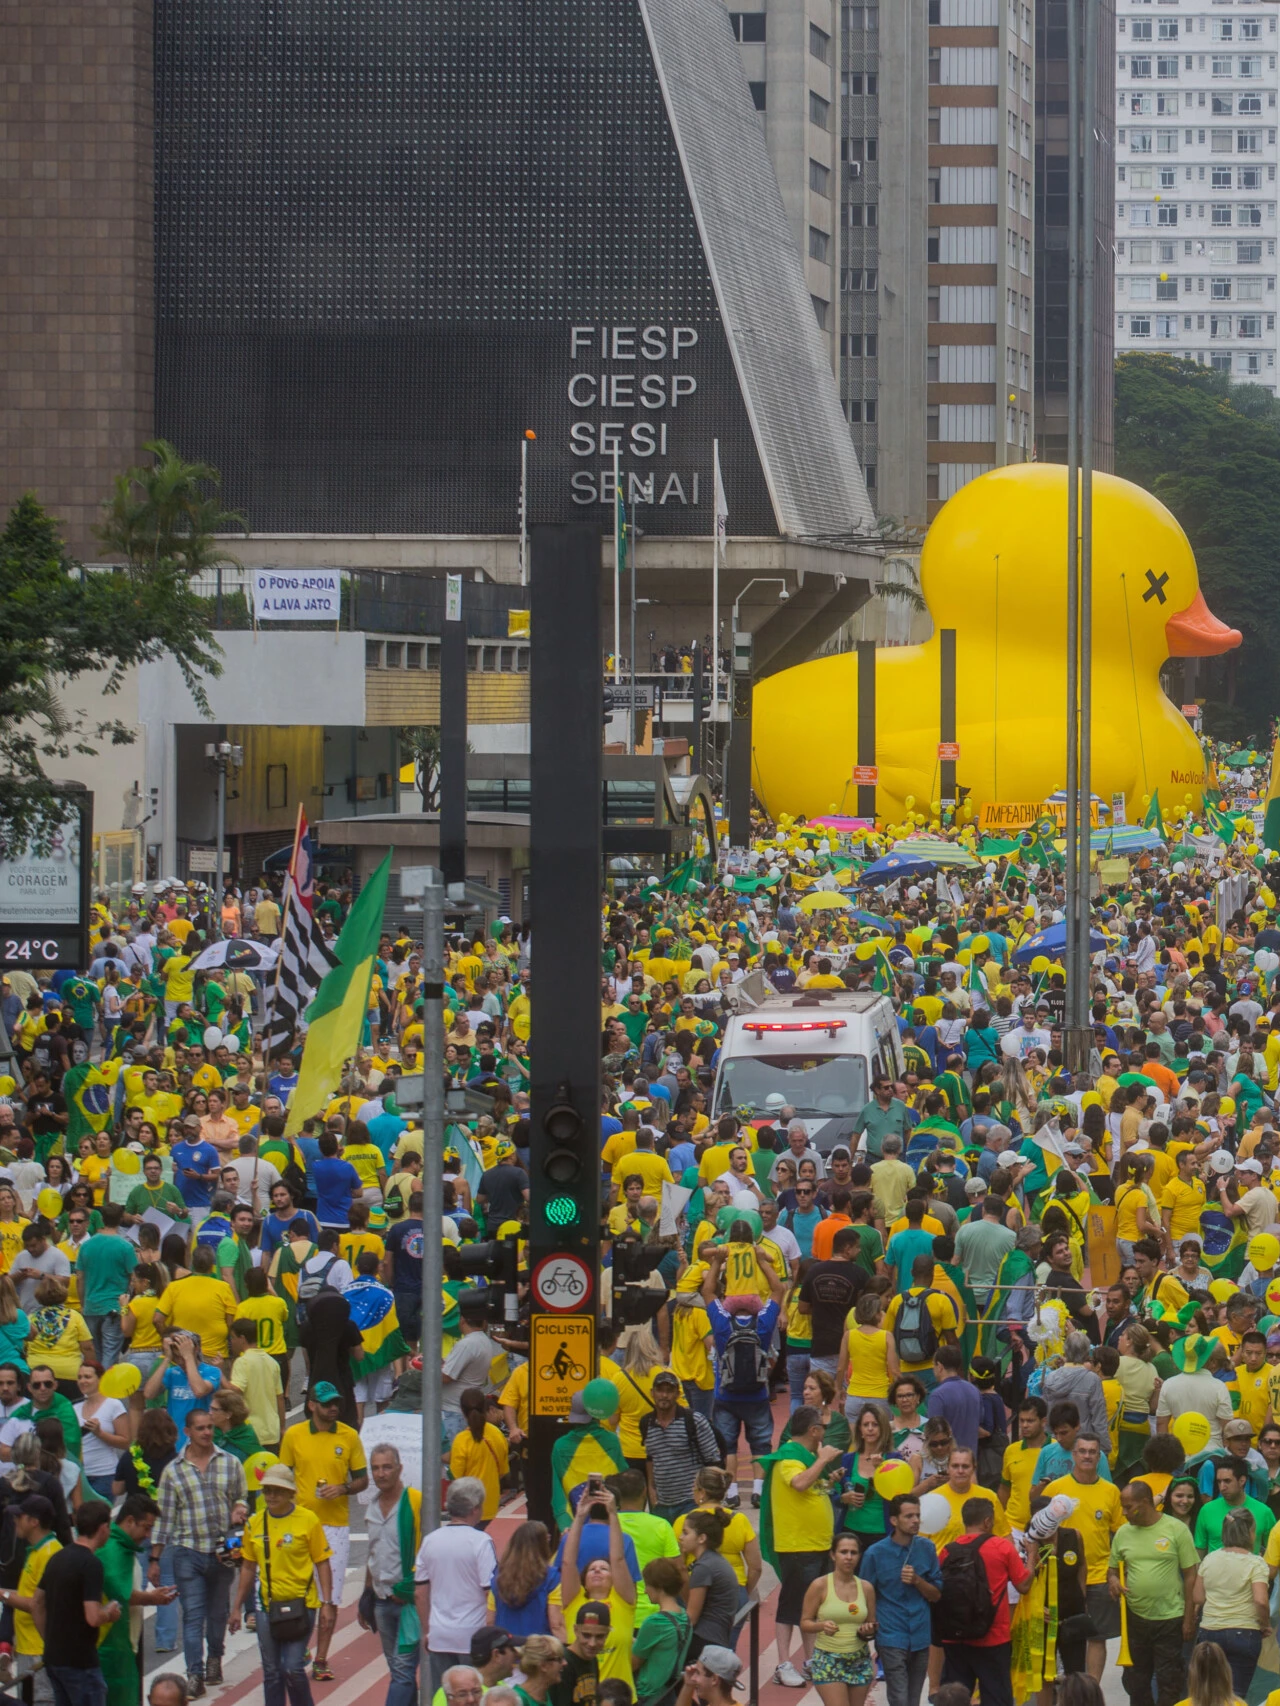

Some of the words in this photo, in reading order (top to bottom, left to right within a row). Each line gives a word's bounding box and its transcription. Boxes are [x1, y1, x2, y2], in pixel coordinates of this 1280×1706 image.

[571, 325, 698, 360] FIESP
[567, 373, 697, 409] CIESP
[569, 422, 666, 456] SESI
[571, 471, 699, 504] SENAI
[259, 578, 266, 589] O
[270, 578, 299, 589] POVO
[302, 577, 335, 589] APOIA
[263, 599, 270, 610] A
[274, 599, 301, 610] LAVA
[304, 599, 331, 610] JATO
[8, 874, 68, 887] CORAGEM
[4, 939, 59, 961] 24°C
[733, 1251, 753, 1281] 10
[536, 1324, 590, 1335] CICLISTA
[556, 1386, 568, 1394] SÓ
